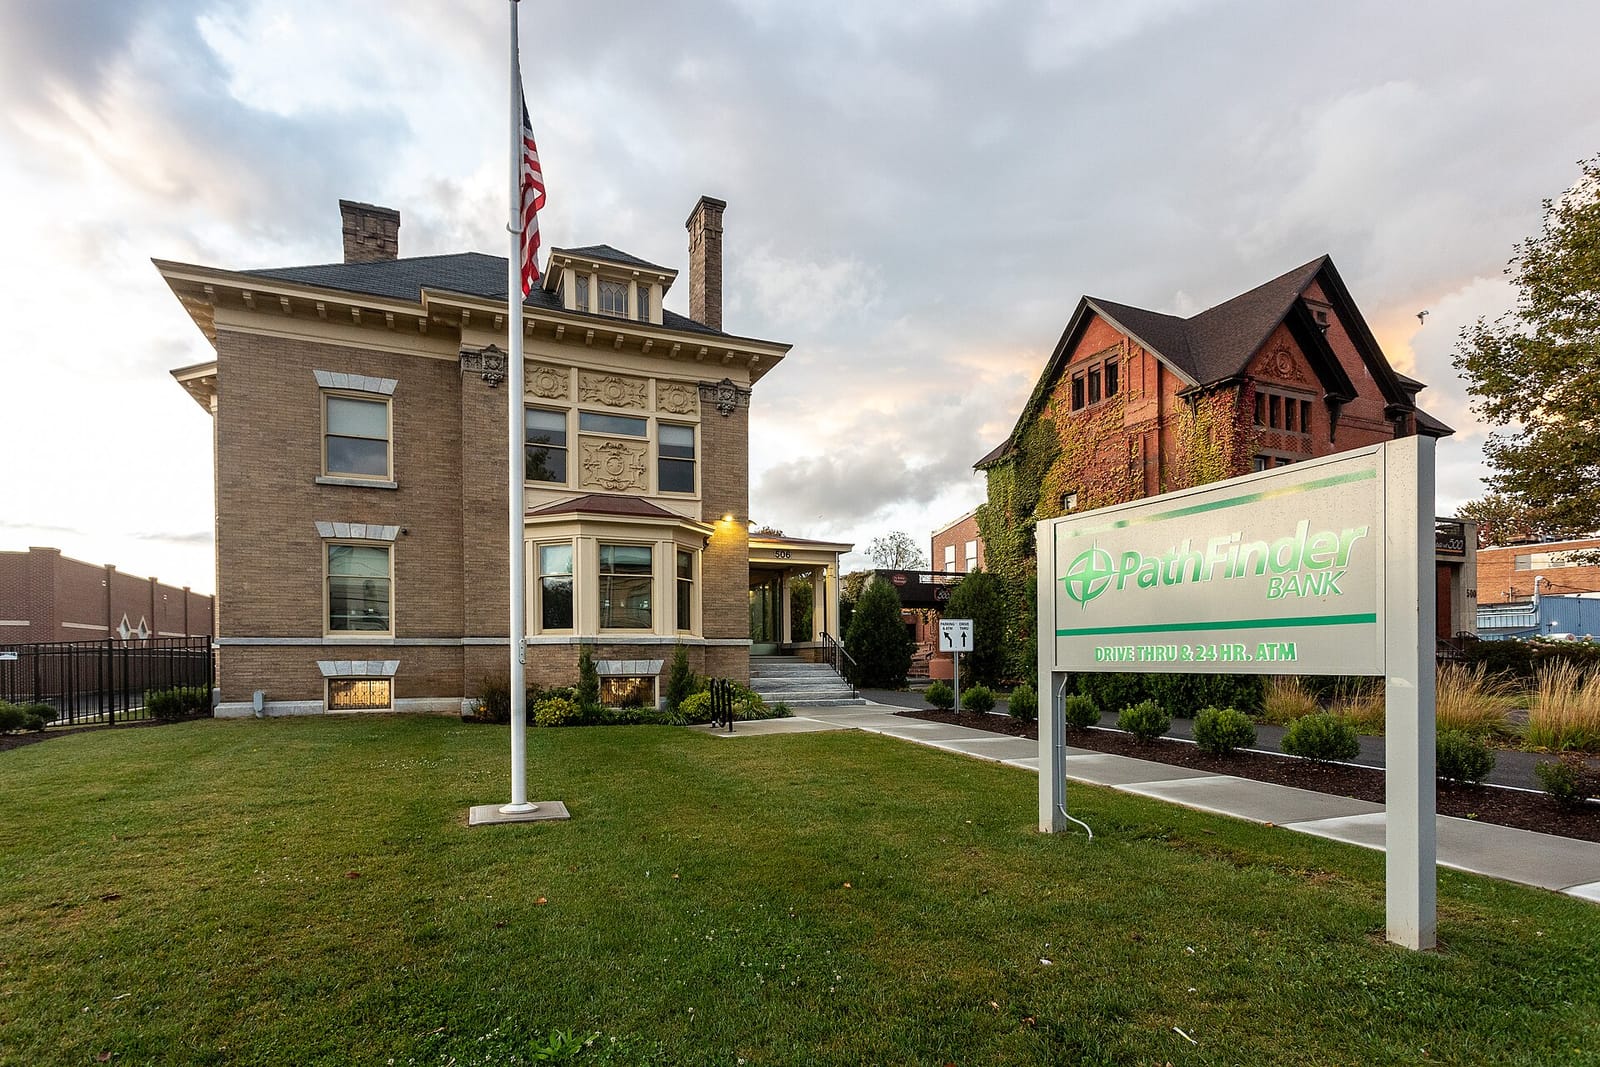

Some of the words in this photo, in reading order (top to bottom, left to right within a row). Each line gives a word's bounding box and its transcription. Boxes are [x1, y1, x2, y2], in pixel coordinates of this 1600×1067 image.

[775, 551, 791, 559] 506
[1116, 520, 1369, 591] PathFinder
[1266, 571, 1345, 600] BANK
[1095, 646, 1135, 662] DRIVE
[1136, 645, 1177, 662] THRU
[1179, 645, 1194, 662] &
[1195, 645, 1218, 662] 24
[1219, 644, 1252, 662] HR.
[1255, 642, 1297, 661] ATM
